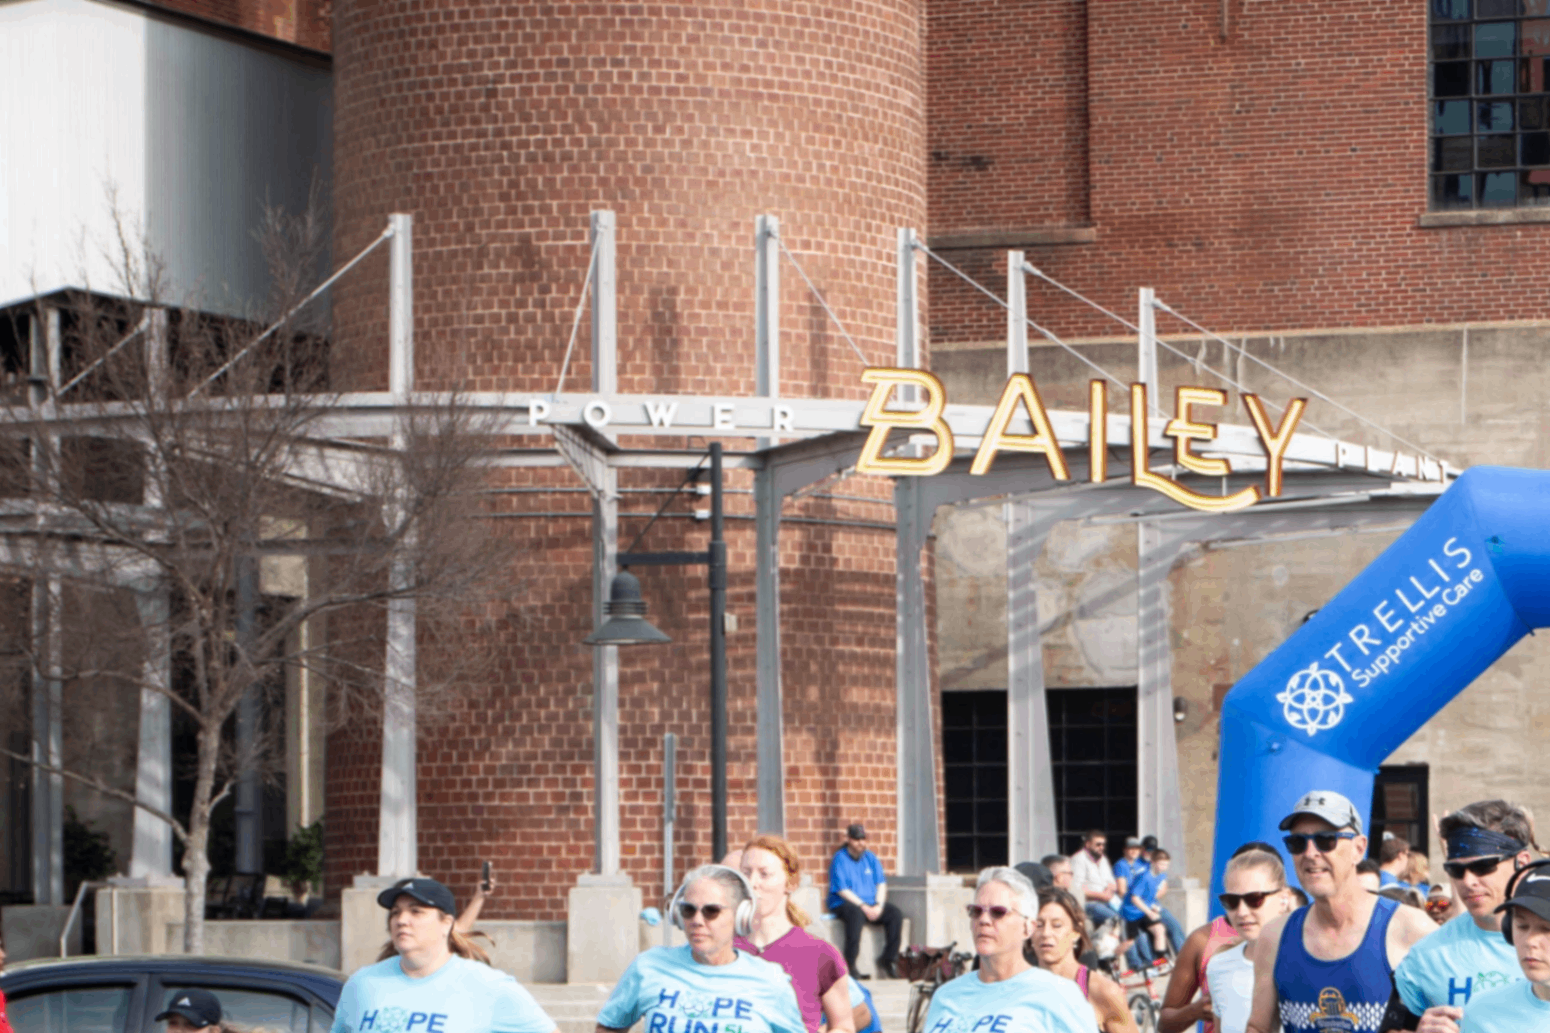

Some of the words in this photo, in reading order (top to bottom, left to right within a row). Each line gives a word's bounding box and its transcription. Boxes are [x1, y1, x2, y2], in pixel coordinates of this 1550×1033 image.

[528, 399, 795, 433] POWER
[855, 367, 1308, 513] BAILEY
[1335, 441, 1450, 485] PLANT
[1324, 537, 1472, 673] TRELLIS
[1351, 602, 1447, 688] Supportive
[1442, 568, 1484, 606] Care
[658, 988, 753, 1021] HOPE
